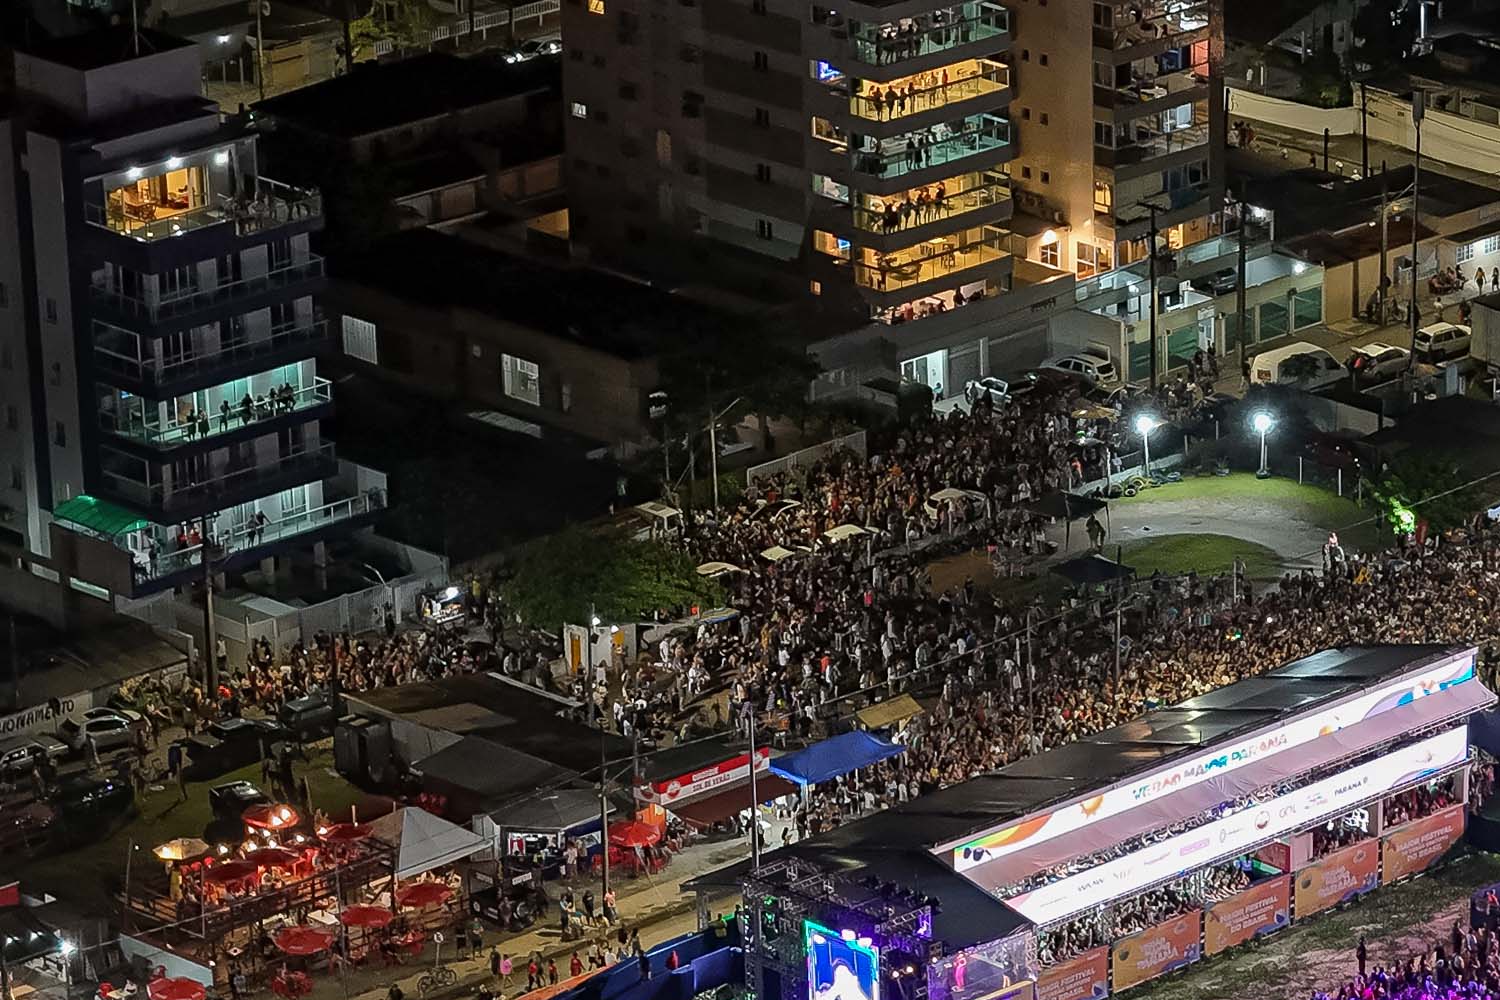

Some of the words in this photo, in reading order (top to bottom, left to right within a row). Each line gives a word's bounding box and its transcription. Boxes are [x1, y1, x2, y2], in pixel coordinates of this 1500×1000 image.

[1420, 824, 1455, 843] FESTIVAL
[1245, 895, 1279, 914] FESTIVAL
[1060, 967, 1097, 986] FESTIVAL
